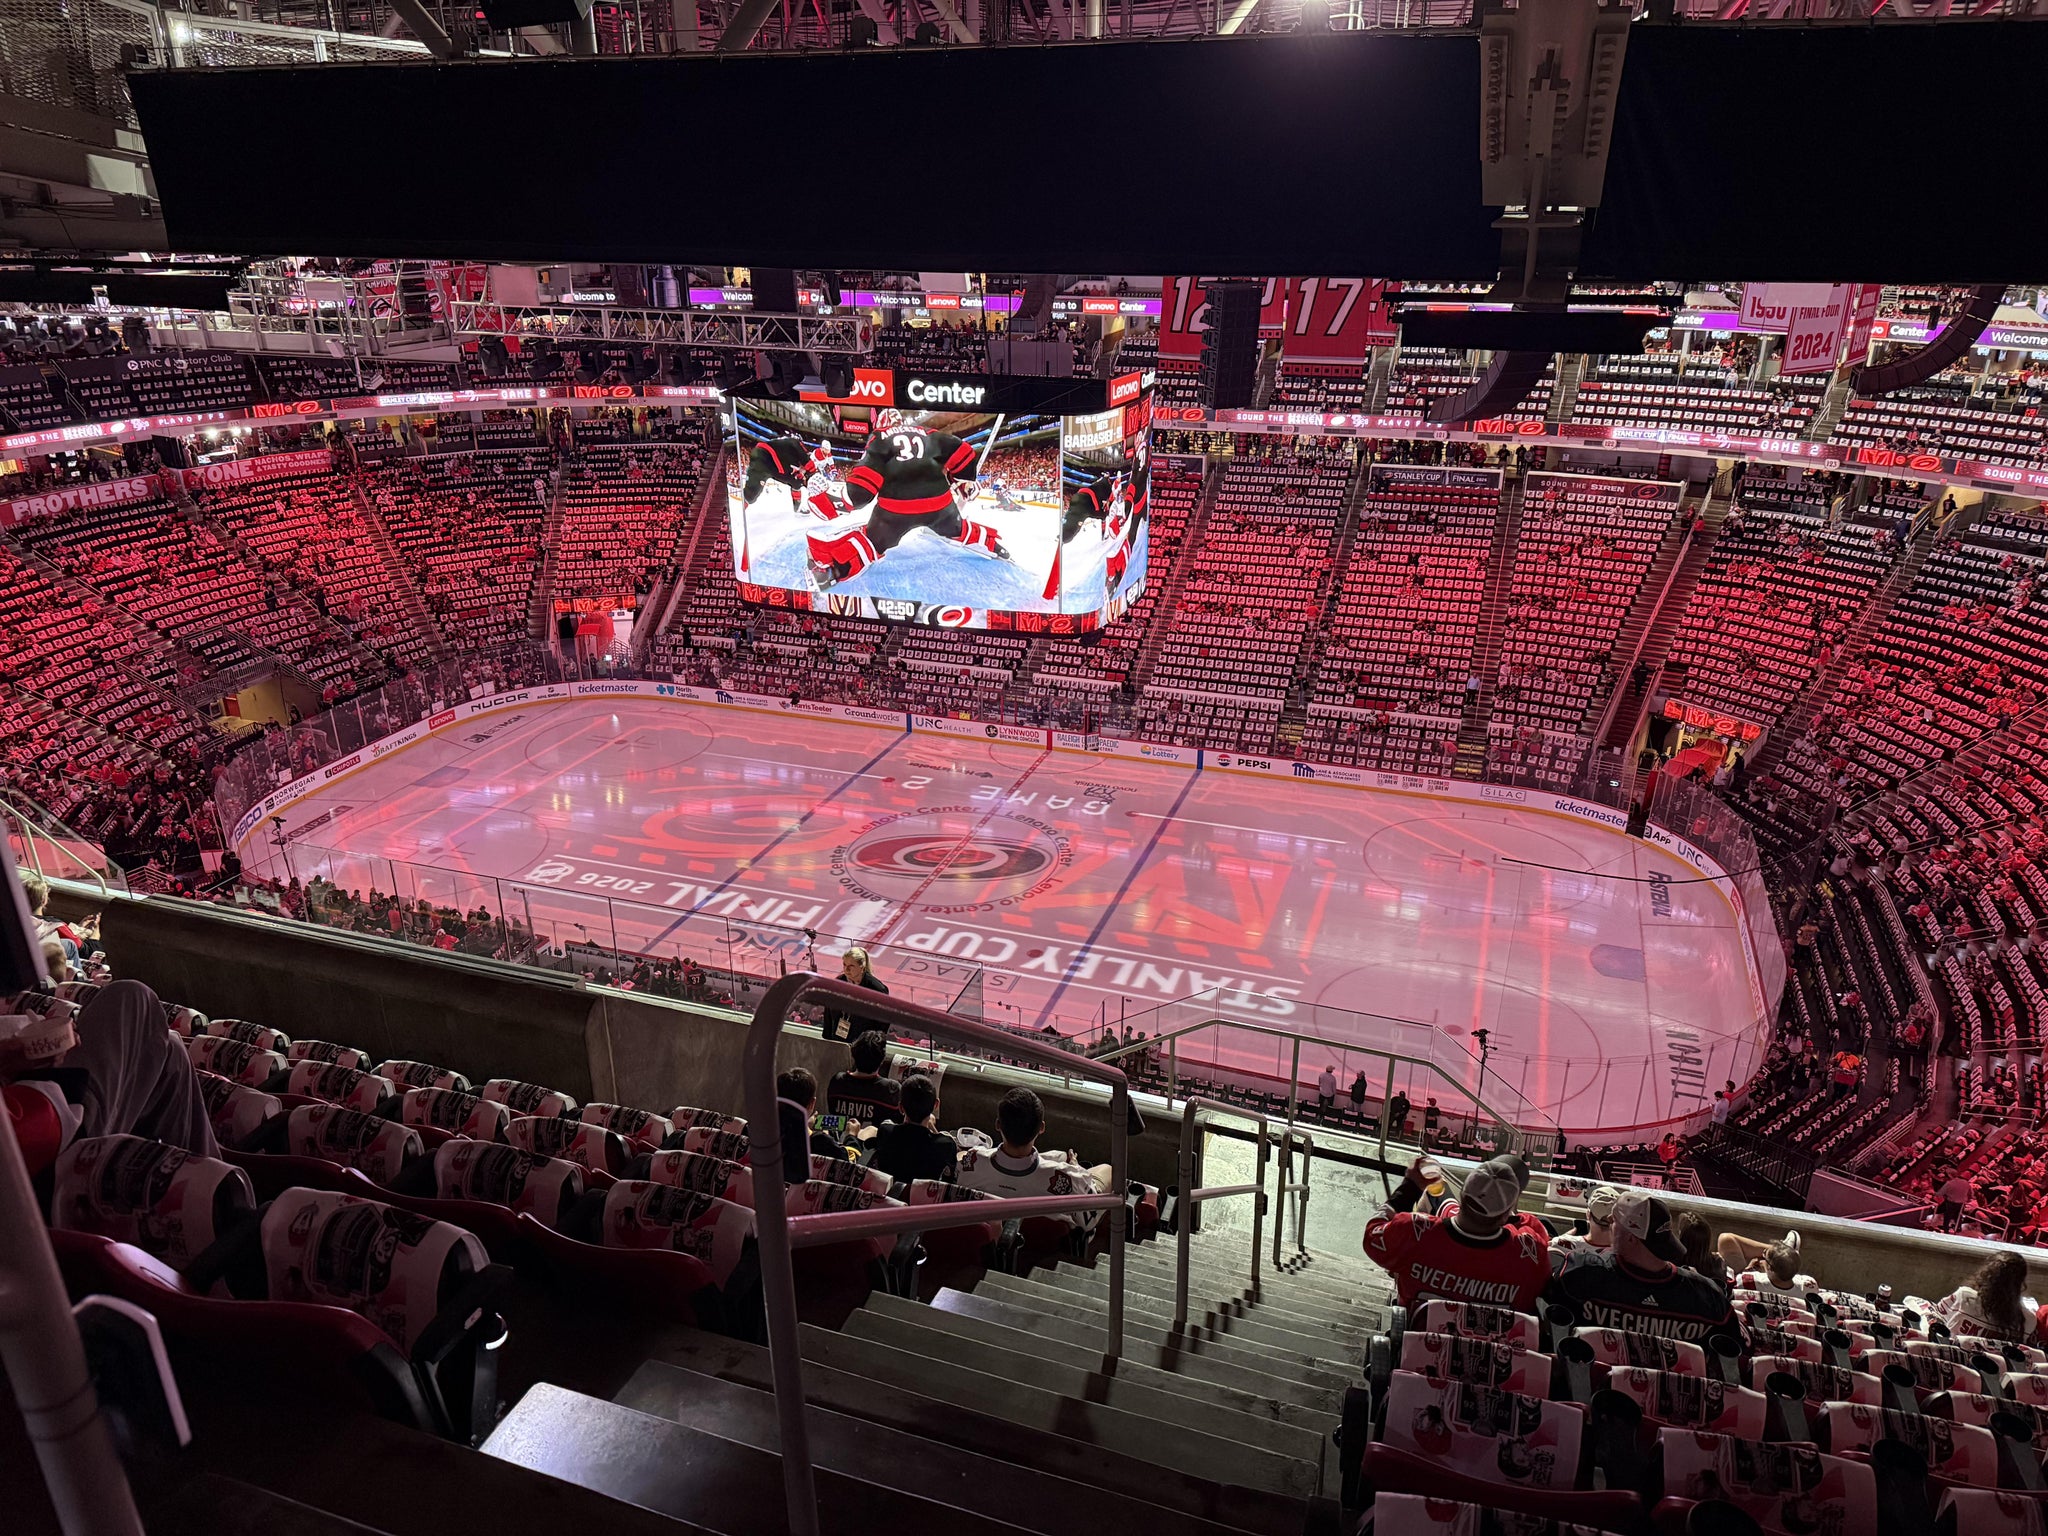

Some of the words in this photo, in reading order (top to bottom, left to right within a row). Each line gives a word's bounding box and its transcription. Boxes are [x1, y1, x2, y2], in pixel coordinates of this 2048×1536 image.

[606, 292, 616, 300] to
[912, 297, 920, 305] to
[929, 298, 956, 306] Lenovo
[960, 298, 986, 307] Center
[1067, 302, 1077, 310] to
[1086, 302, 1115, 311] Lenovo
[1119, 302, 1146, 312] Center
[1294, 277, 1365, 336] 17
[1800, 306, 1820, 320] FINAL
[1890, 324, 1928, 337] Center
[1992, 331, 2048, 345] Welcome
[1791, 332, 1834, 360] 2024
[140, 360, 162, 368] PNC
[210, 354, 232, 363] Club
[501, 388, 531, 399] GAME
[539, 389, 546, 398] 2
[664, 388, 688, 396] SOUND
[691, 388, 706, 396] THE
[907, 379, 985, 404] Center
[1112, 380, 1138, 400] Lenovo
[1236, 413, 1264, 421] SOUND
[1268, 414, 1284, 422] THE
[844, 422, 867, 432] Lenovo
[6, 436, 36, 446] SOUND
[40, 432, 60, 442] THE
[1605, 440, 1615, 448] 122
[1612, 430, 1642, 438] STANLEY
[1668, 433, 1688, 442] FINAL
[893, 435, 924, 462] 31
[1760, 440, 1798, 452] GAME
[1810, 445, 1819, 456] 2
[255, 455, 294, 466] NACHOS,
[295, 451, 330, 461] WRAPS
[263, 462, 287, 472] TASTY
[288, 457, 330, 467] GOODNESS
[1826, 460, 1838, 468] 123
[1393, 472, 1426, 480] STANLEY
[1426, 474, 1441, 482] CUP
[1984, 468, 2022, 480] SOUND
[2028, 474, 2048, 485] THE
[1540, 480, 1567, 488] SOUND
[1572, 482, 1586, 490] THE
[1590, 484, 1624, 493] SIREN
[12, 479, 148, 520] BROTHERS
[878, 600, 914, 616] 42:50
[578, 684, 638, 694] ticketmaster
[676, 686, 692, 694] North
[676, 692, 700, 700] Carolina
[471, 693, 528, 712] NUCOR
[811, 704, 832, 712] Teeter
[430, 713, 454, 728] Lenovo
[844, 708, 900, 722] Groundworks
[916, 716, 943, 730] UNC
[944, 725, 972, 733] HEALTH
[1000, 727, 1040, 738] LYNNWOOD
[374, 732, 417, 758] DRAFTKINGS
[1057, 734, 1080, 744] RALEIGH
[1152, 752, 1180, 760] Lottery
[1238, 758, 1270, 770] PEPSI
[332, 756, 360, 774] CHIPOTLE
[274, 775, 316, 800] NORWEGIAN
[902, 774, 933, 790] 2
[276, 794, 293, 806] CRUISE
[296, 787, 307, 797] LINE
[970, 784, 1112, 816] GAME
[1484, 787, 1523, 800] SILAC
[850, 810, 914, 836] Lenovo
[917, 804, 981, 814] Center
[1554, 800, 1627, 828] ticketmaster
[234, 806, 262, 840] GEICO
[1006, 810, 1058, 836] Lenovo
[1055, 833, 1072, 868] Center
[1652, 831, 1671, 845] App
[830, 845, 847, 878] Center
[1678, 841, 1704, 867] UNC
[577, 872, 655, 894] 2026
[842, 875, 893, 906] Lenovo
[1001, 878, 1062, 907] Lenovo
[665, 882, 823, 926] FINAL
[920, 903, 994, 914] Center
[715, 928, 806, 956] UNC
[904, 928, 1017, 962] CUP
[1025, 946, 1300, 1015] STANLEY
[1666, 1030, 1708, 1100] NOBULL
[836, 1100, 874, 1118] JARVIS
[1411, 1263, 1521, 1302] SVECHNIKOV
[1583, 1301, 1712, 1341] SVECHNIKOV
